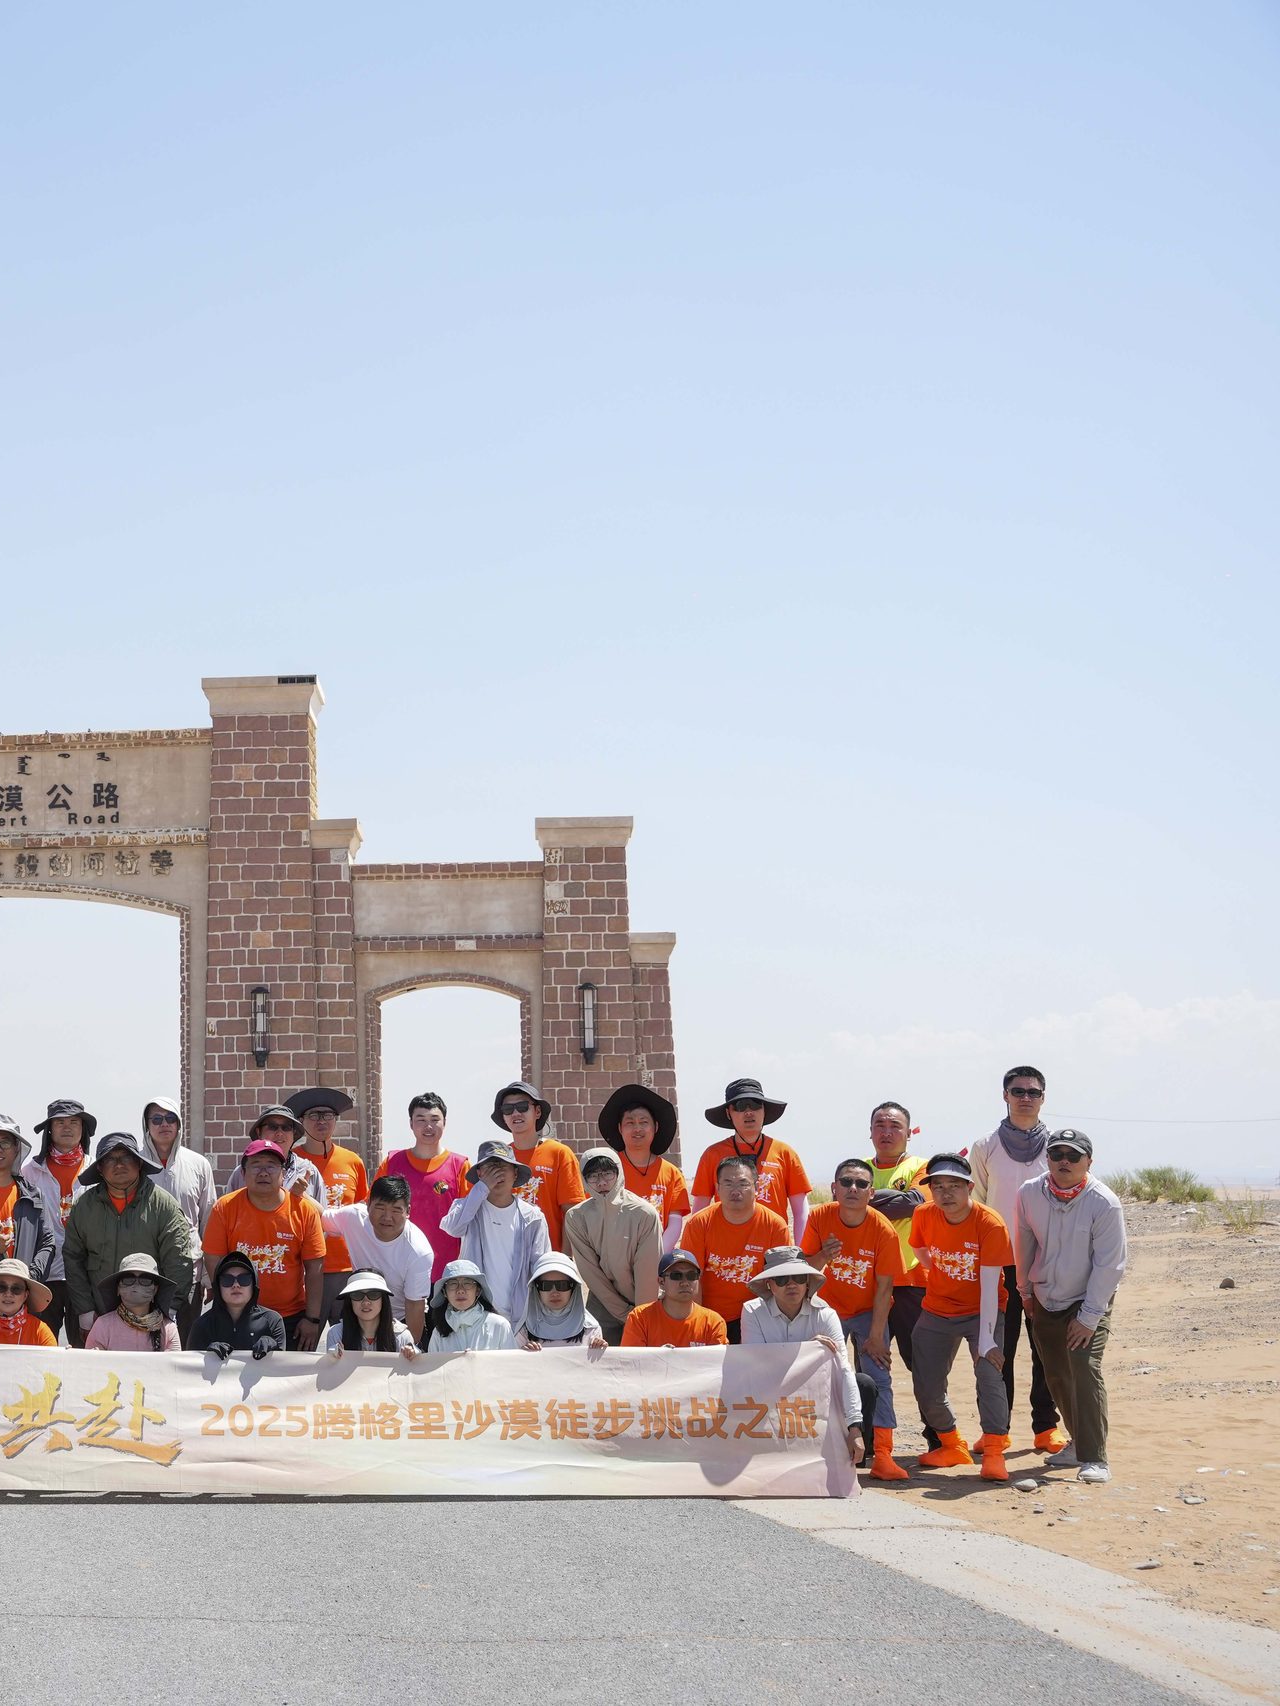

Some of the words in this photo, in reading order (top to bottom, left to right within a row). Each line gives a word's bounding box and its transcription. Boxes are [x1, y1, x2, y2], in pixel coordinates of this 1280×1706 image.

[68, 811, 120, 825] Road
[200, 1396, 819, 1441] 2025腾格里沙漠徒步挑战之旅
